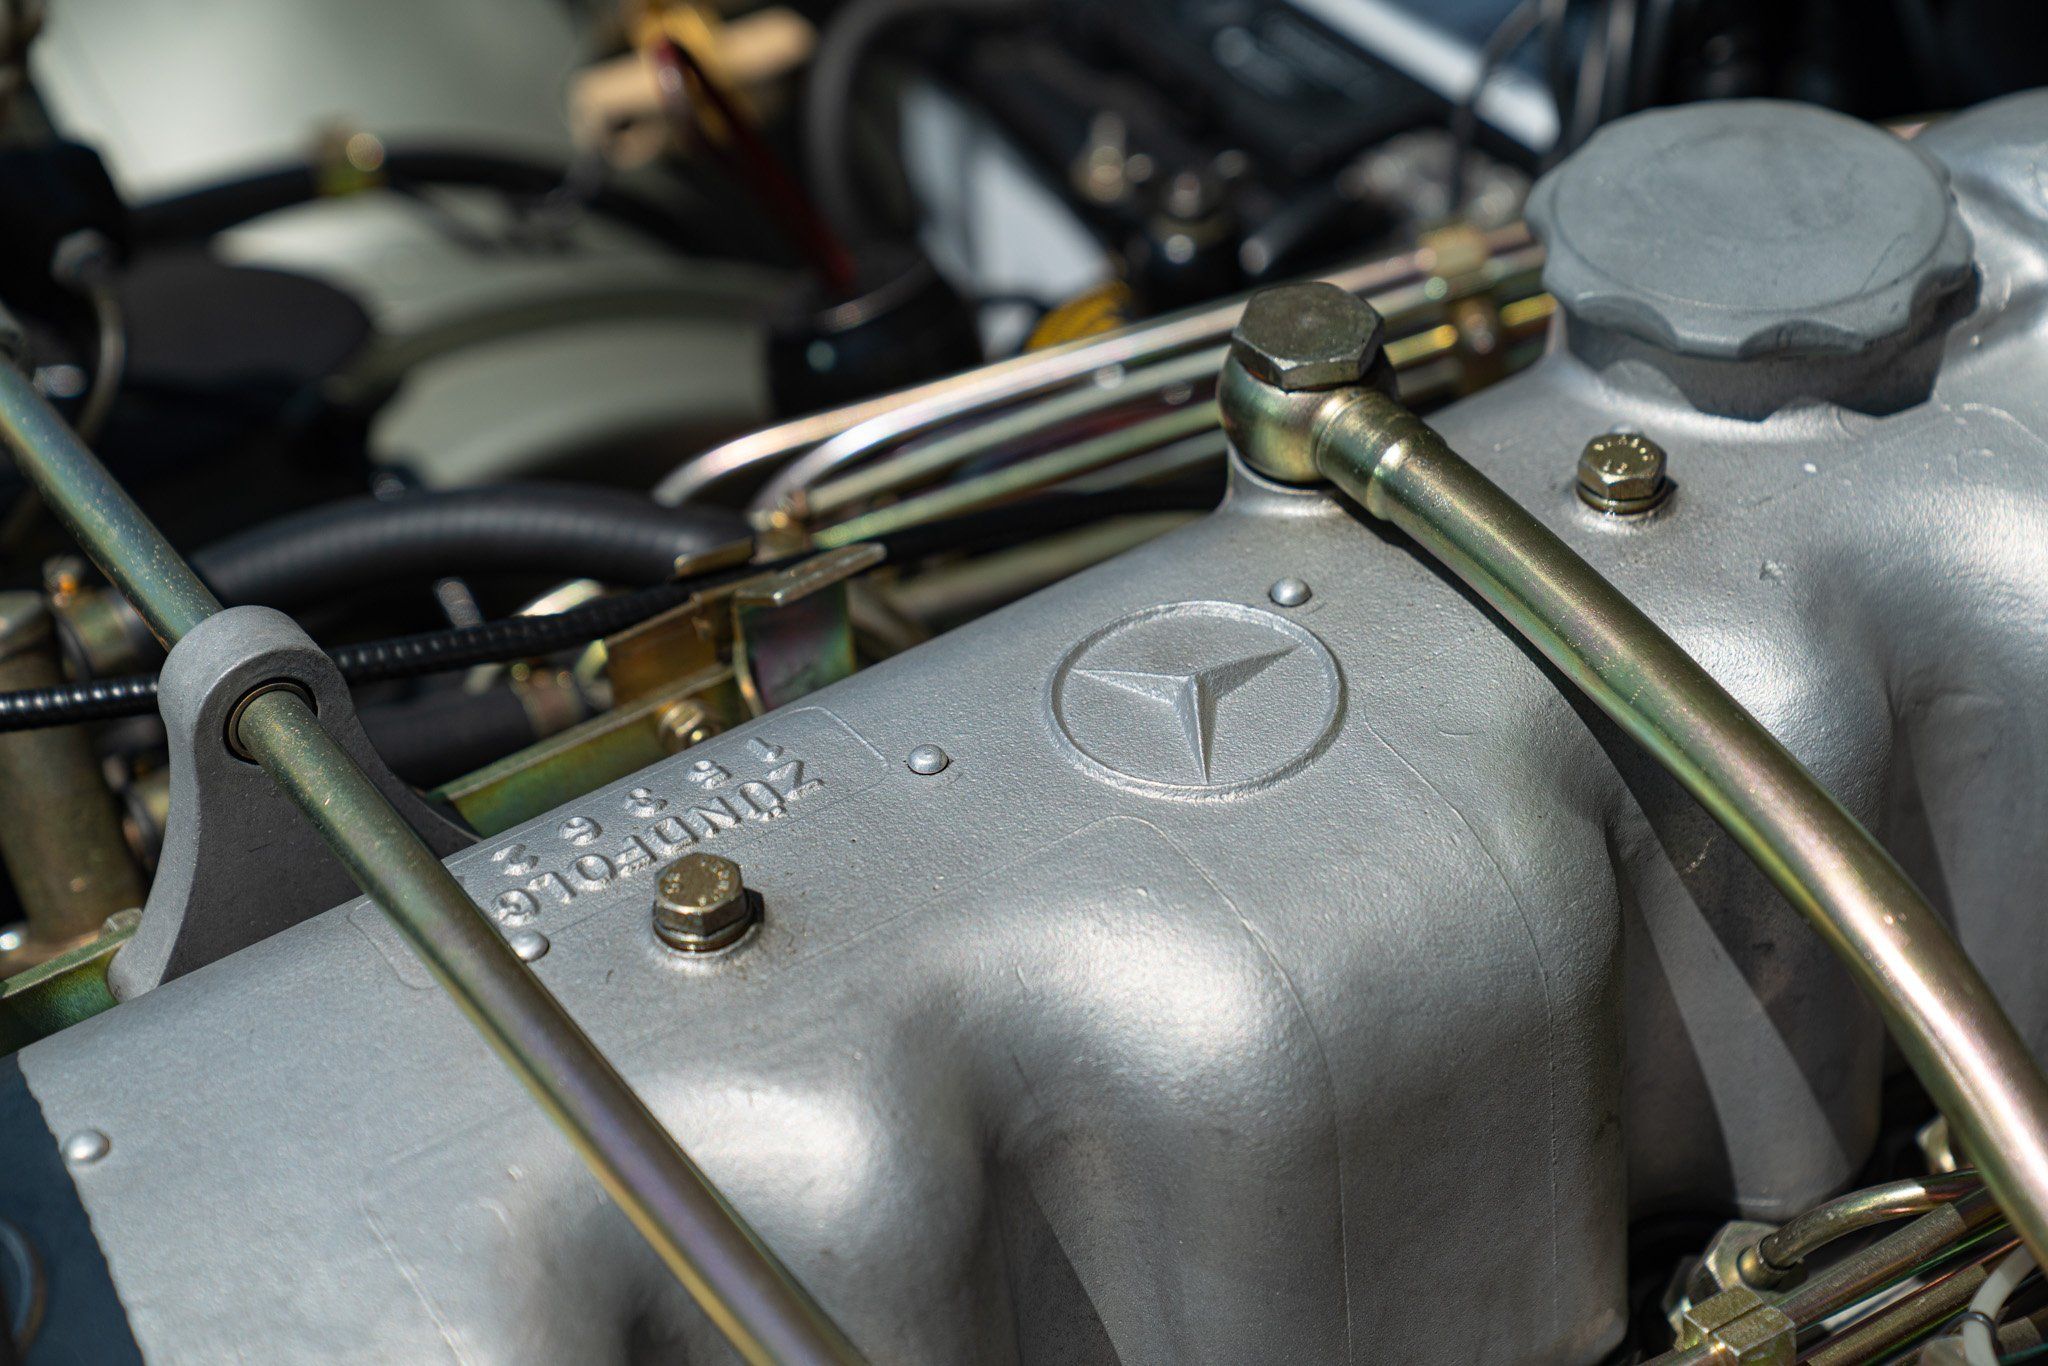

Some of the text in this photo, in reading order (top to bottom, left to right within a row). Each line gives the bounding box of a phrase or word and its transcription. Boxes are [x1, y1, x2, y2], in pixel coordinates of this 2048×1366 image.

[746, 737, 784, 762] 1
[624, 787, 668, 818] 3
[494, 761, 823, 927] ZÜNDFOLG
